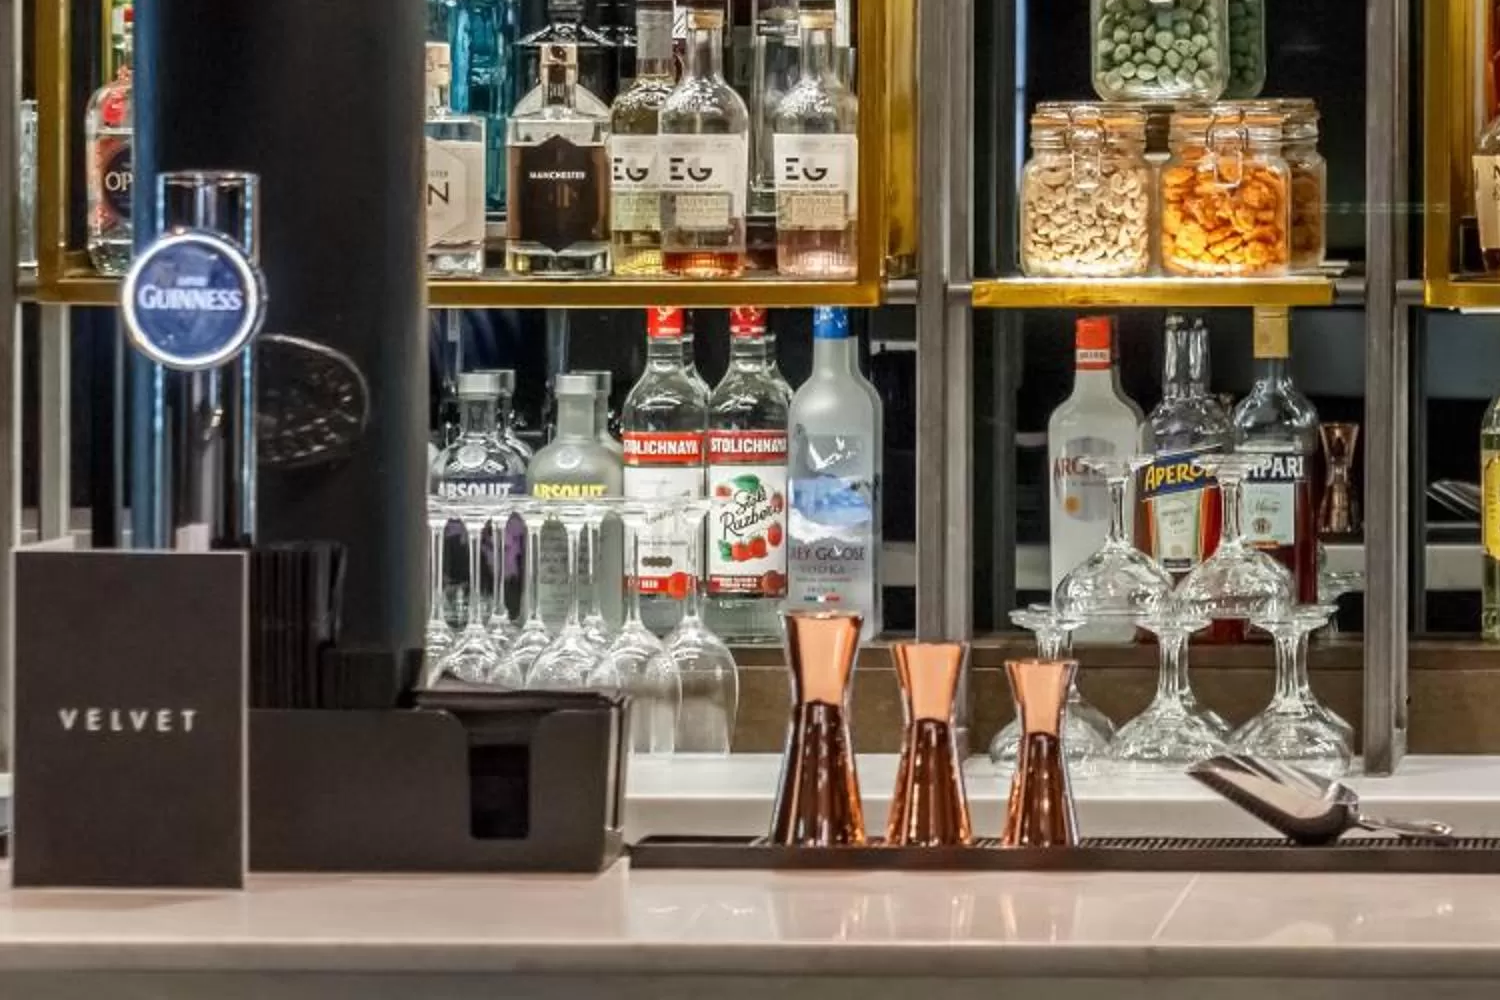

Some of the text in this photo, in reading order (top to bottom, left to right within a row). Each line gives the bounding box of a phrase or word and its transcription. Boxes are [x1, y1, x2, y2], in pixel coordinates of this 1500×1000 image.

[528, 171, 587, 180] MANCHESTER
[137, 283, 243, 311] GUINNESS
[437, 482, 513, 498] ABSOLUT
[532, 482, 609, 499] ABSOLUT
[57, 707, 199, 733] VELVET
